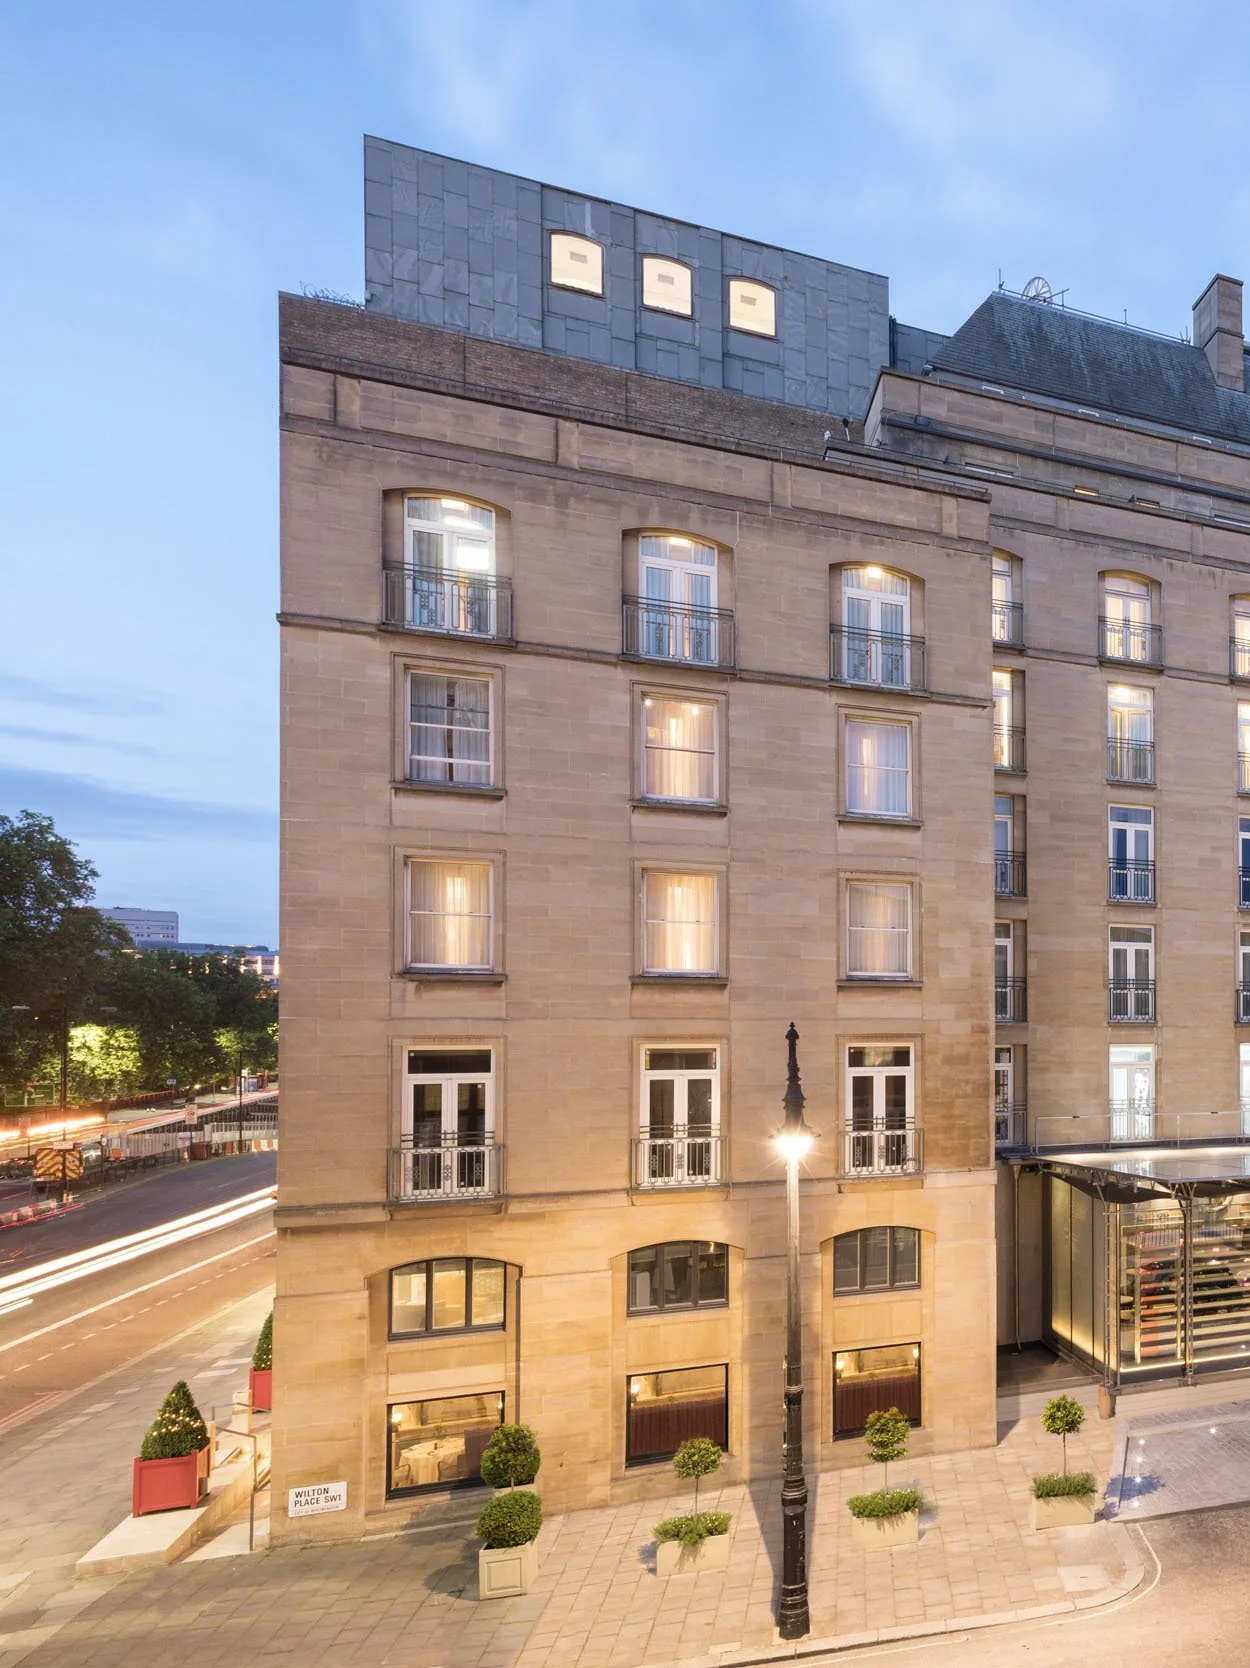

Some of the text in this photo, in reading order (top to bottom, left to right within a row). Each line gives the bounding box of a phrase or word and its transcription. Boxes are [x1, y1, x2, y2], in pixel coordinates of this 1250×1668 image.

[294, 1487, 329, 1498] WILTON
[294, 1494, 341, 1507] PLACE SW1
